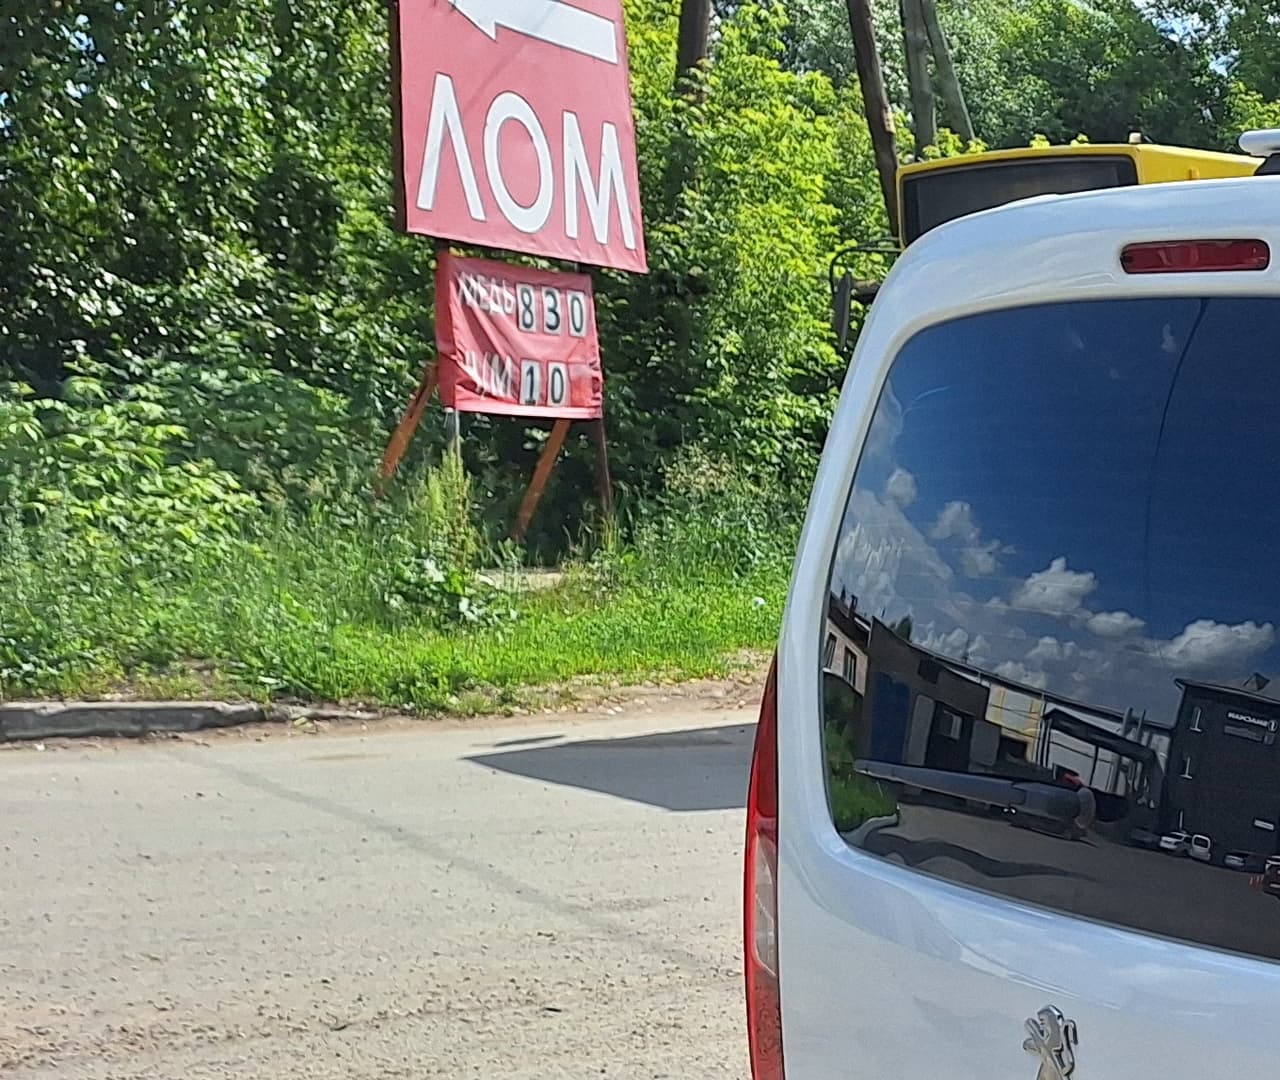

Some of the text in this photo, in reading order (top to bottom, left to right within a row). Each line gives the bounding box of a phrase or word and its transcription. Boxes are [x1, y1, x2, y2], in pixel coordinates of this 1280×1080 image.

[417, 73, 636, 251] ЛОМ
[519, 286, 585, 335] 830
[523, 364, 566, 405] 10
